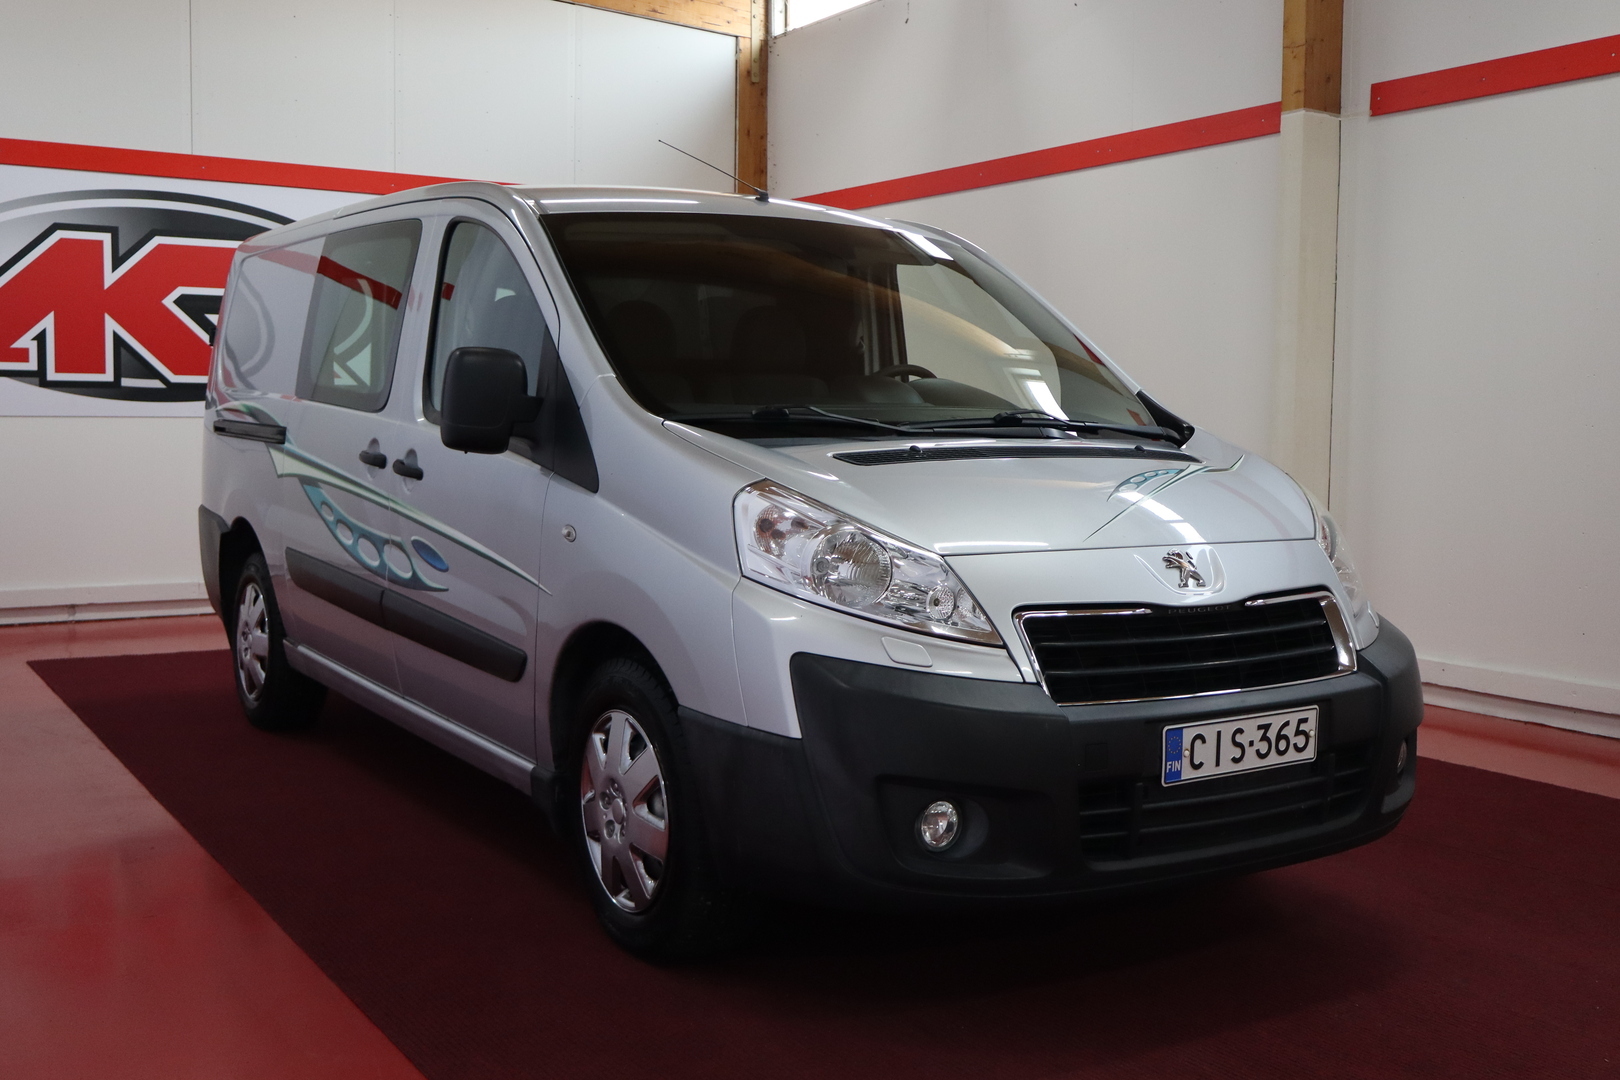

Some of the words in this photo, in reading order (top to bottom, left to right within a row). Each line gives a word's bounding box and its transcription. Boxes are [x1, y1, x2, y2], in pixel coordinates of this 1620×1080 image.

[1168, 604, 1232, 615] PEUGEOT
[1189, 717, 1310, 770] CIS-365
[1166, 759, 1182, 774] FIN
